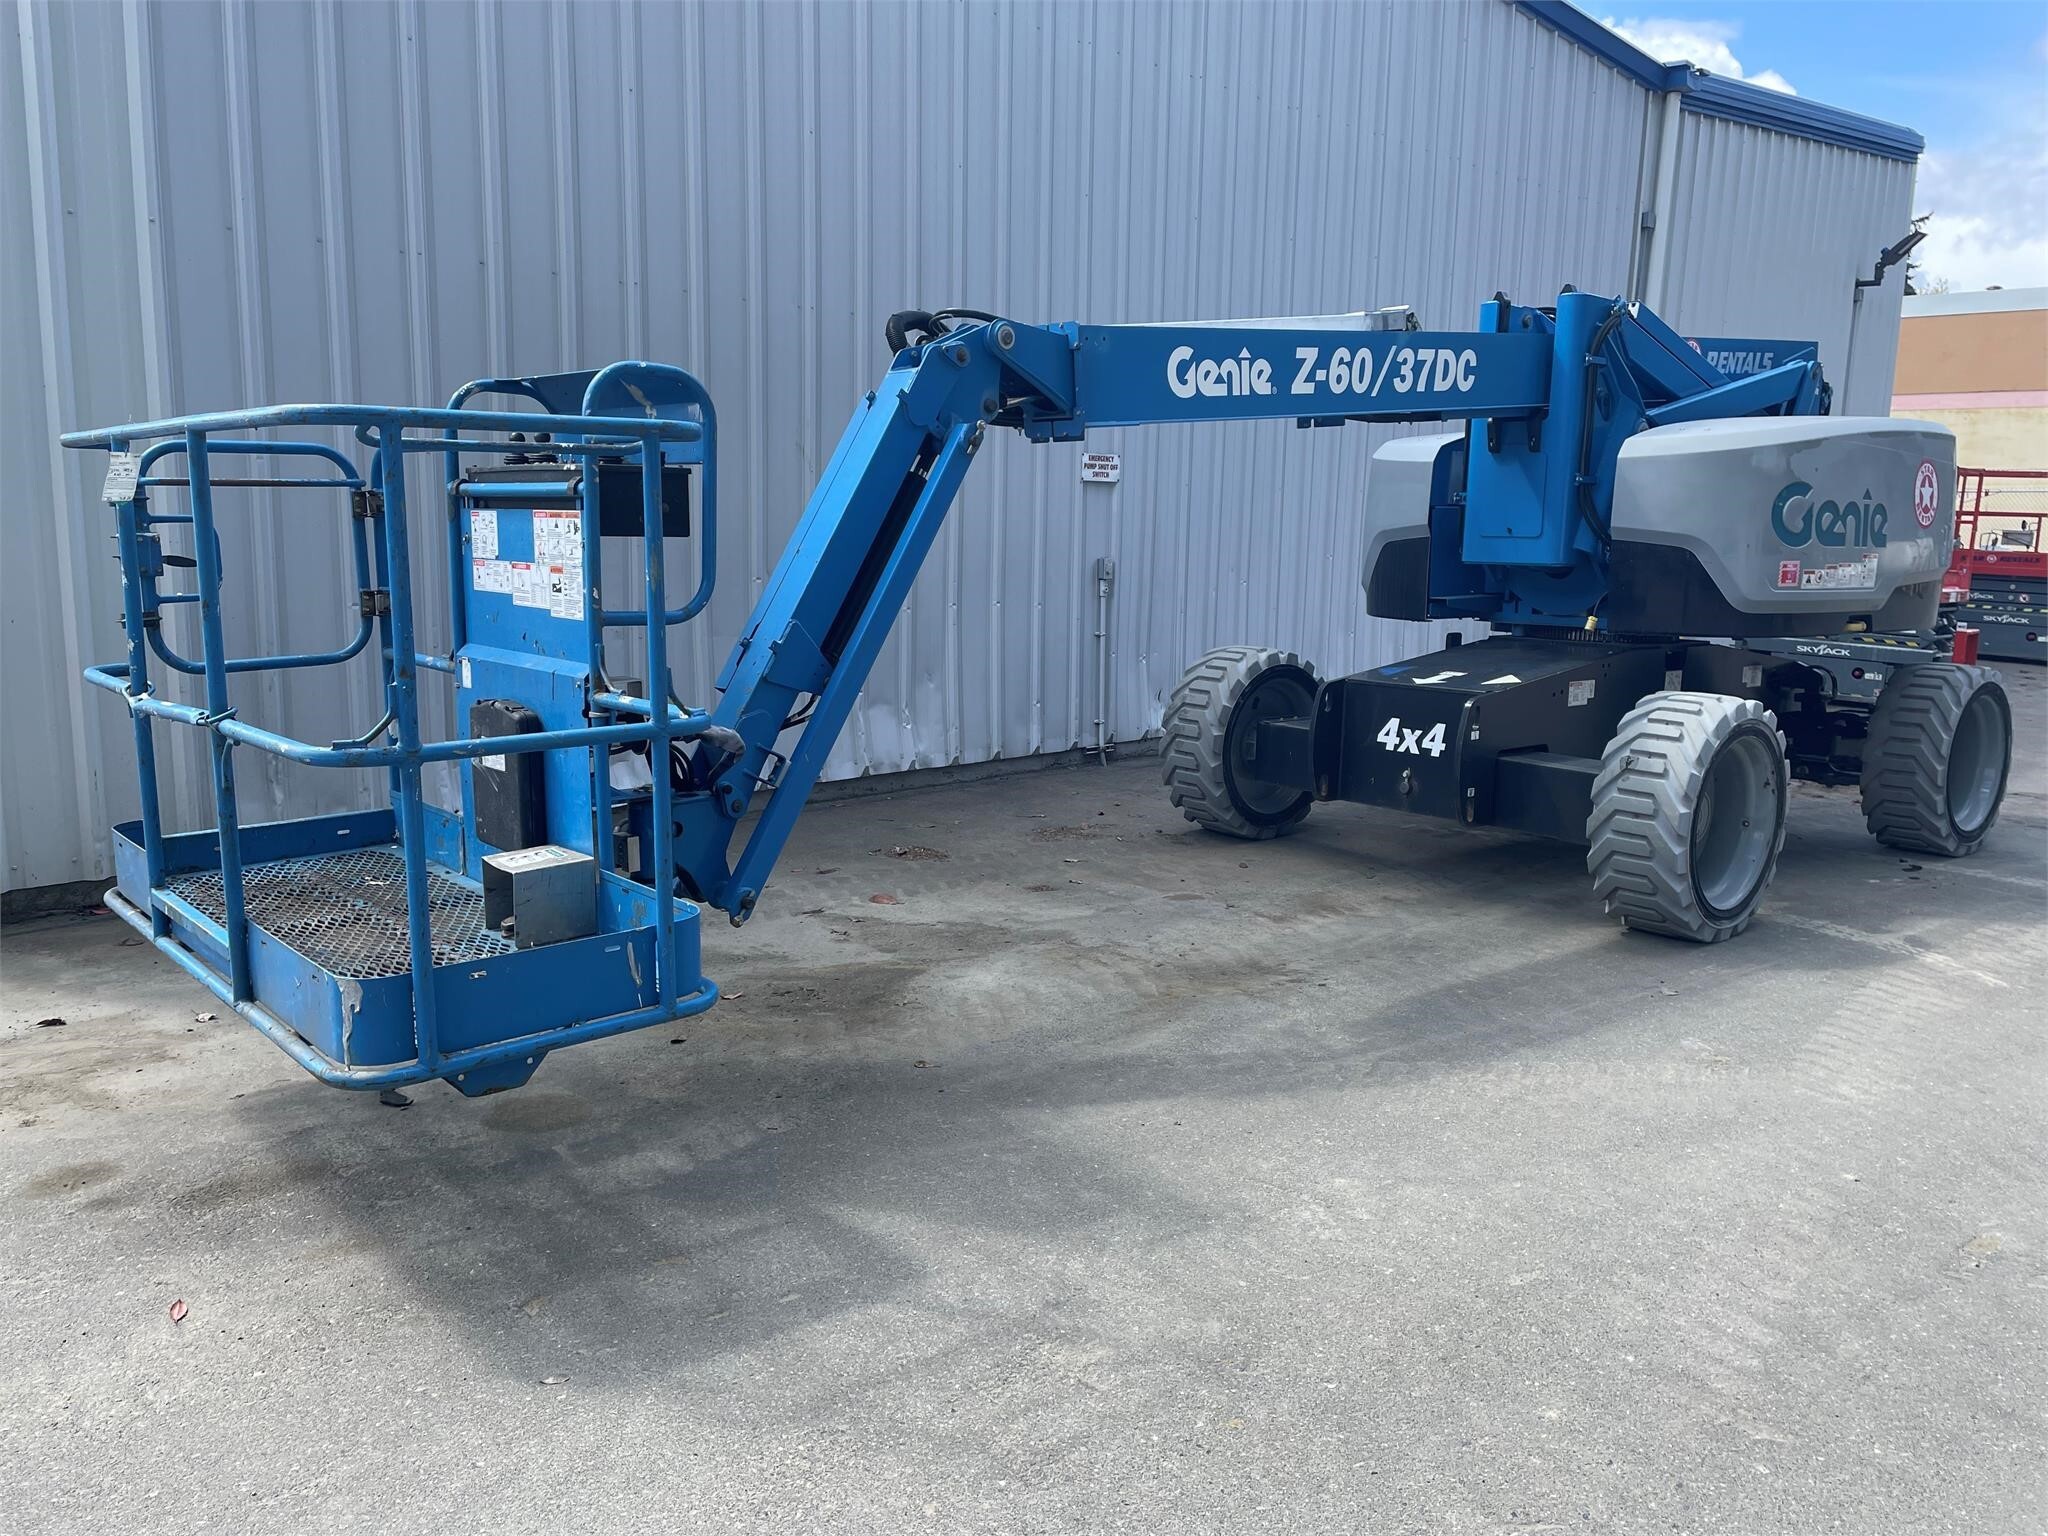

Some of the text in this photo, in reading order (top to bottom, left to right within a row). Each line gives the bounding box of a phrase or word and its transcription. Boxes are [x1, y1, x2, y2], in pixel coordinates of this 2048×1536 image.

[1167, 345, 1477, 398] Genie Z-60/37DC
[1706, 352, 1774, 374] RENTALS
[1771, 480, 1888, 548] Genie
[1982, 614, 2030, 624] SKYJACK
[1796, 644, 1851, 656] SKYJACK
[1376, 717, 1447, 757] 4x4
